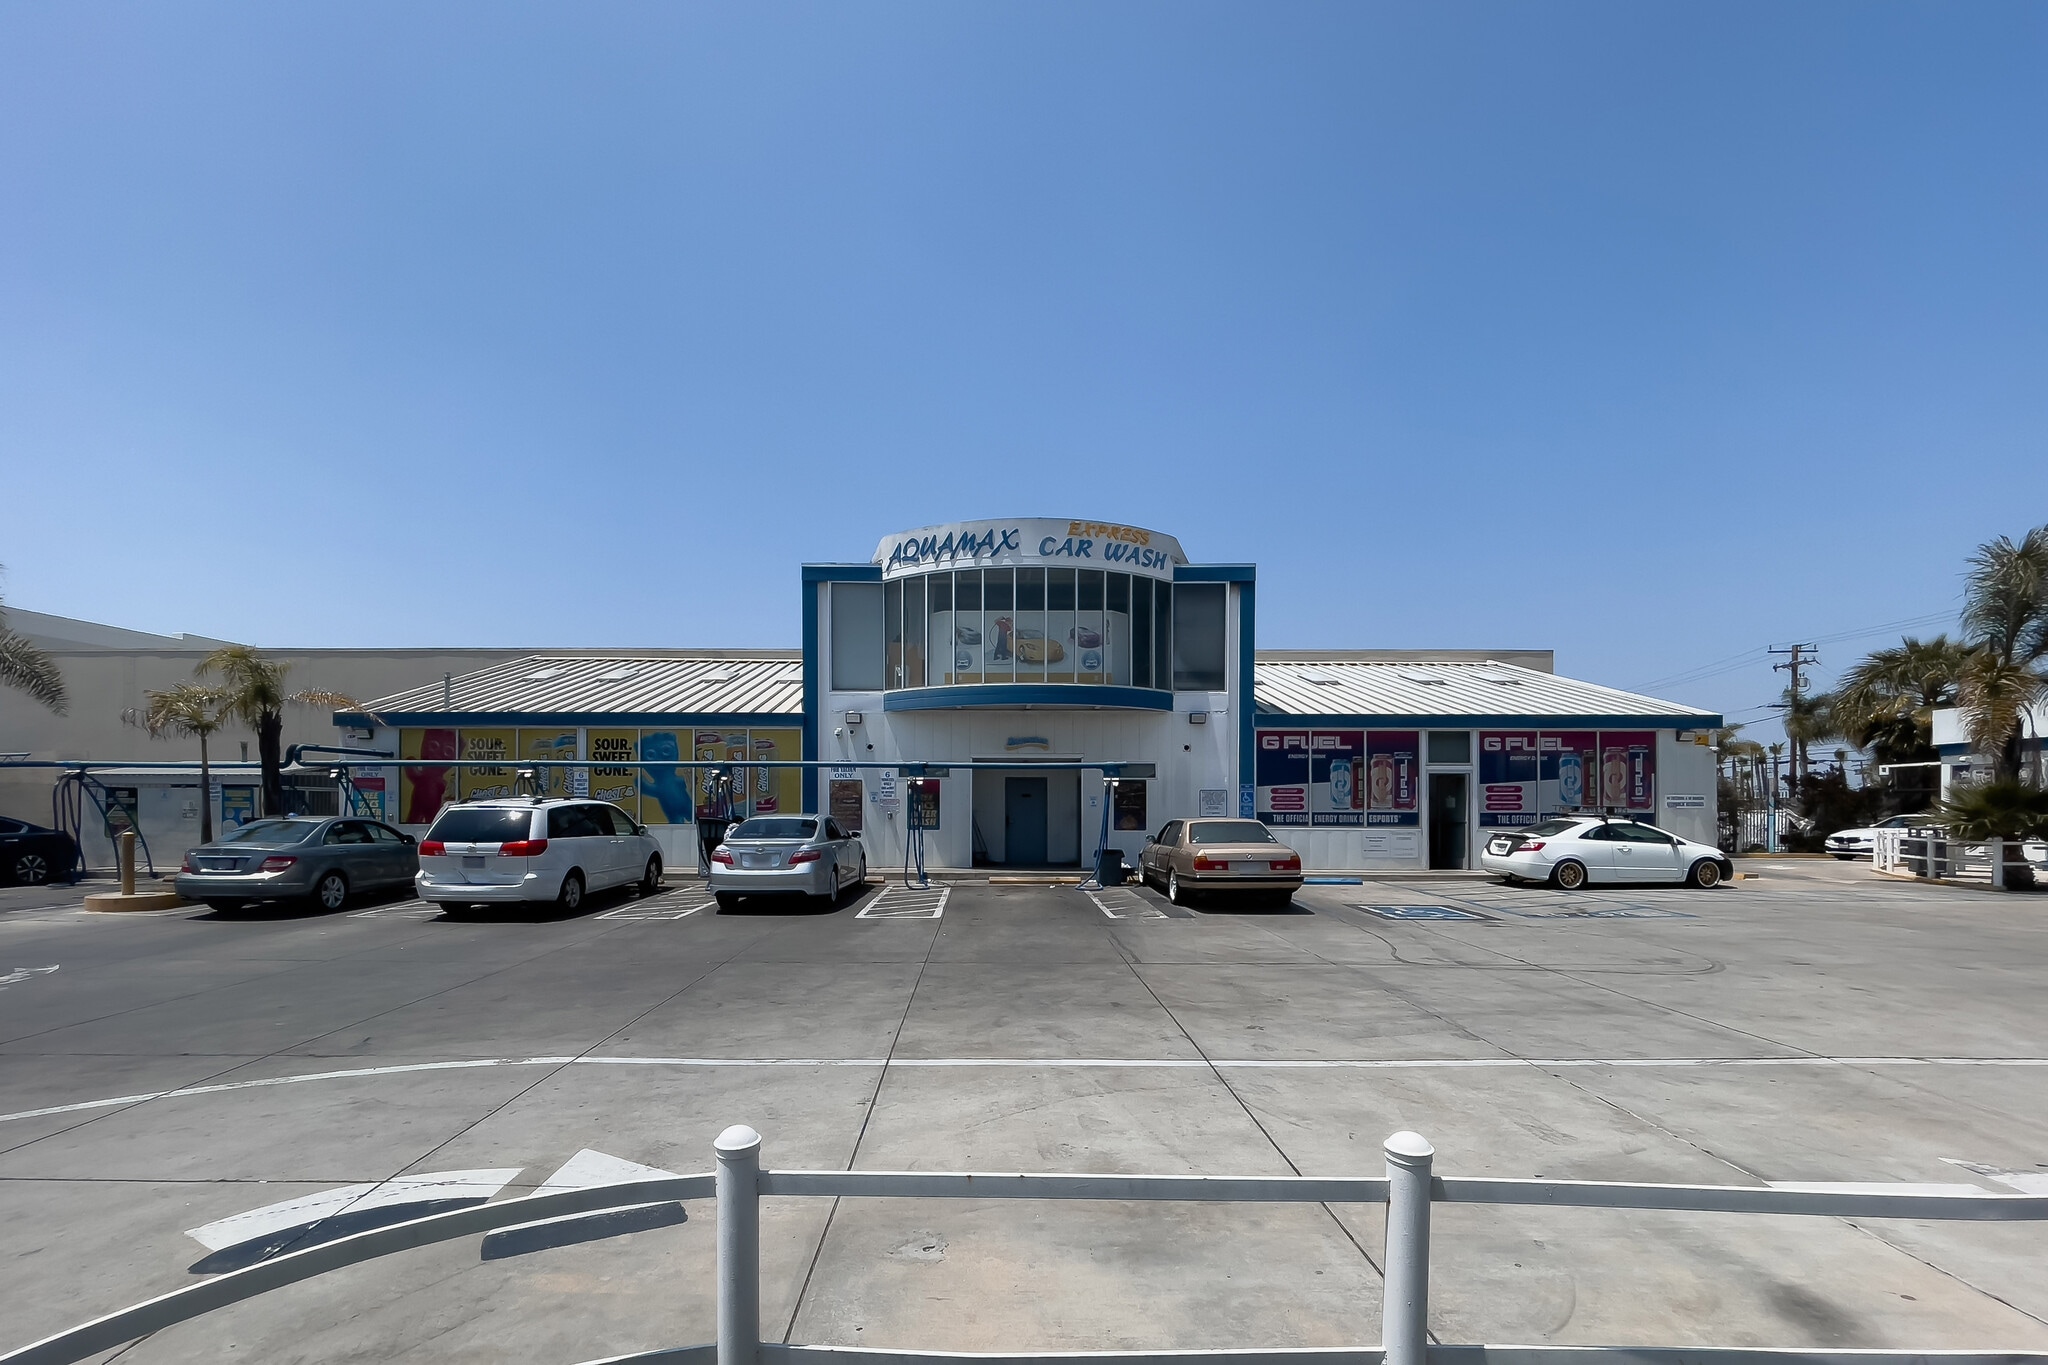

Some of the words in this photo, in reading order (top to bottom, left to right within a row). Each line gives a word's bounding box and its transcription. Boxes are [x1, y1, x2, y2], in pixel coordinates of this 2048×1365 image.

[1067, 522, 1150, 545] EXPRESS
[886, 528, 1019, 571] AQUAMAX
[1038, 536, 1093, 558] CAR
[1104, 542, 1168, 570] WASH
[469, 738, 507, 750] SOUR.
[594, 738, 633, 750] SOUR.
[1262, 735, 1280, 750] G
[1283, 735, 1353, 750] FUEL
[1484, 737, 1502, 751] G
[1505, 737, 1574, 751] FUEL
[1498, 815, 1510, 824] THE
[1511, 815, 1537, 824] OFFICIA
